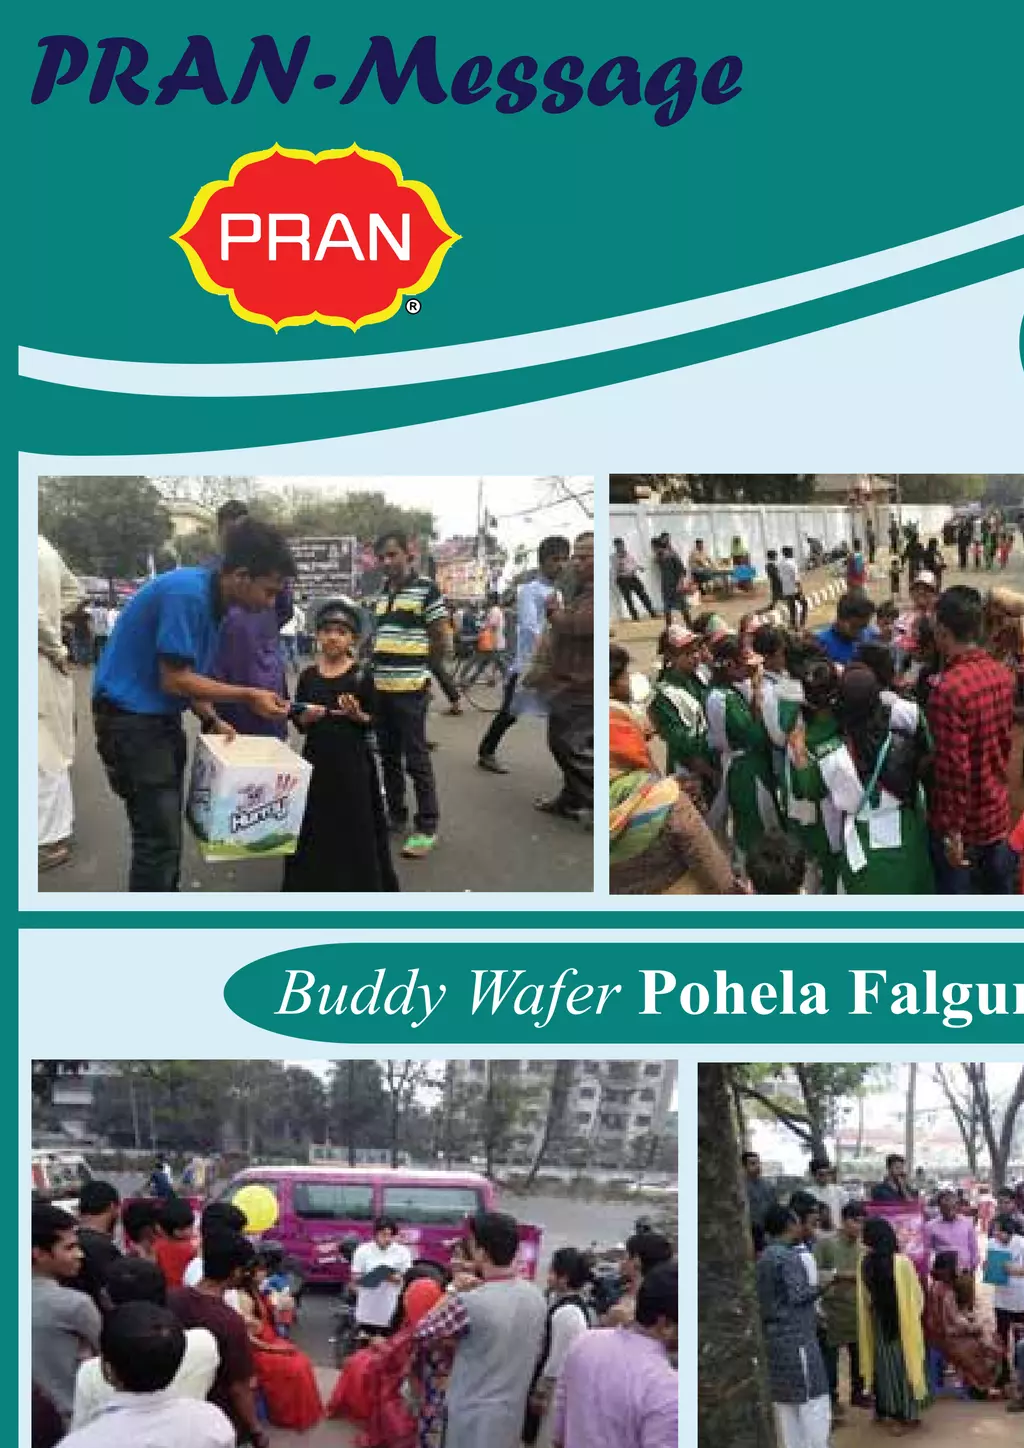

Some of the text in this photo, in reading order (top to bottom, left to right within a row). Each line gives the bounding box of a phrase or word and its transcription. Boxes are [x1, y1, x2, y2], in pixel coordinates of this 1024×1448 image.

[30, 34, 743, 128] PRAN-Message
[220, 212, 411, 261] PRAN
[273, 967, 447, 1029] Buddy
[471, 967, 623, 1029] Wafer
[638, 969, 830, 1016] Pohela
